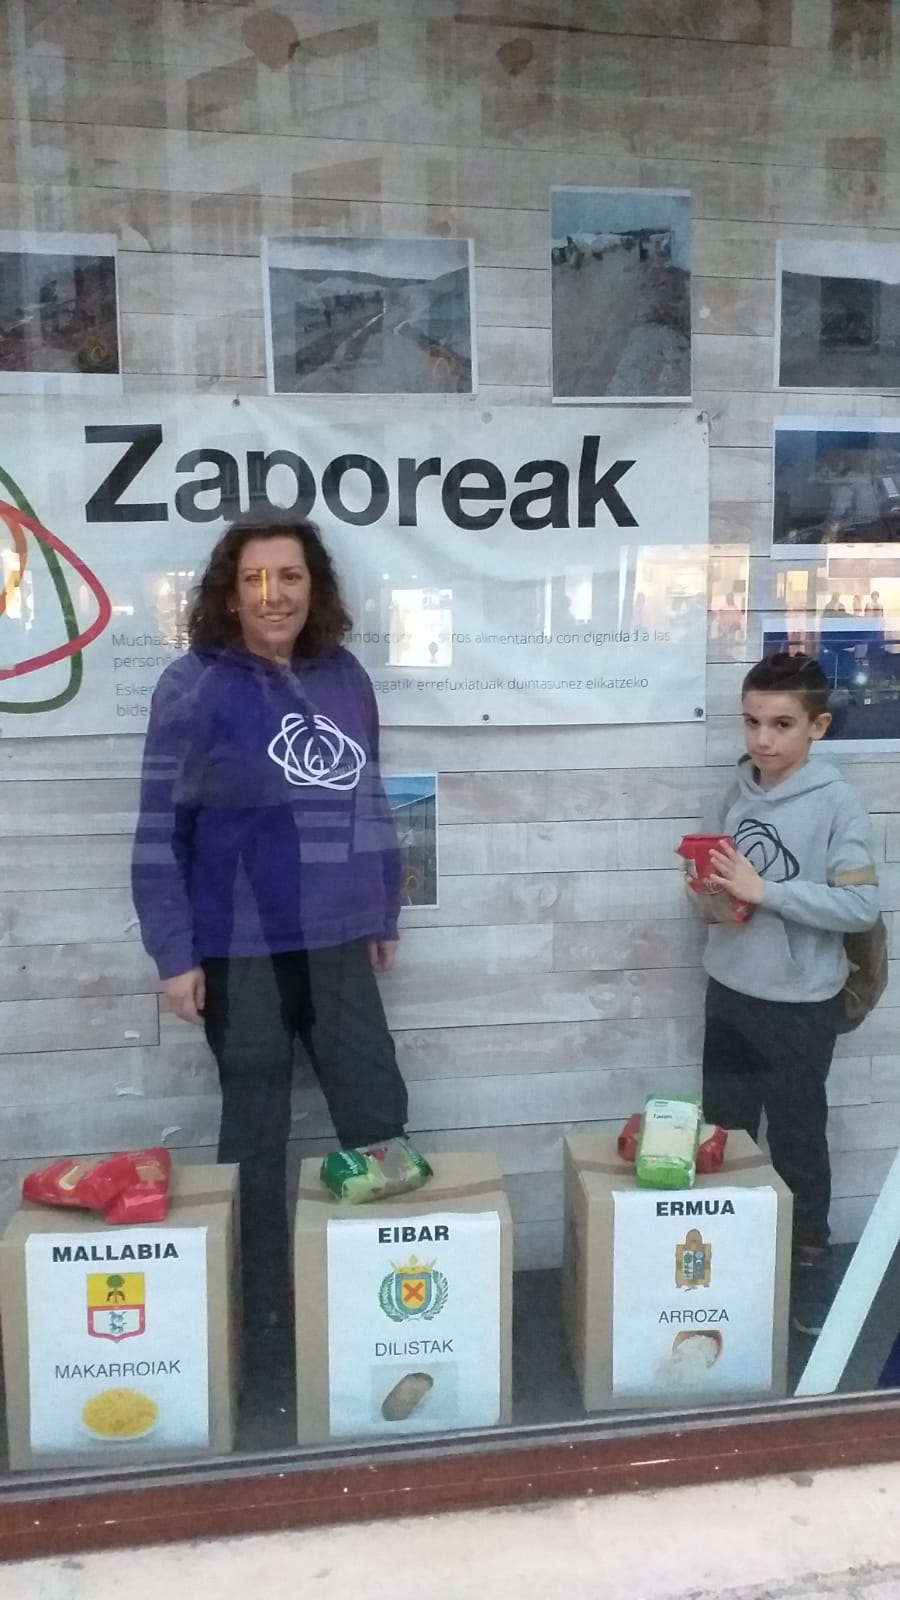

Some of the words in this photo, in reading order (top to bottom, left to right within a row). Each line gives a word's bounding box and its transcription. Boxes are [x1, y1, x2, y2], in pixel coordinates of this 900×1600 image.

[85, 424, 639, 531] Zaporeak
[111, 633, 169, 647] Muchas
[475, 632, 552, 645] alimentando
[556, 632, 580, 644] con
[583, 629, 639, 647] dignidad
[642, 632, 650, 643] a
[654, 629, 672, 643] las
[113, 656, 172, 671] person
[115, 683, 155, 696] Esker
[374, 678, 412, 694] agatik
[416, 678, 503, 692] errefuxiatuak
[507, 677, 583, 691] duintasunez
[586, 675, 649, 690] elikatzeko
[116, 703, 149, 717] bide
[655, 1199, 735, 1218] ERMUA
[377, 1224, 450, 1244] EIBAR
[52, 1242, 179, 1263] MALLABIA
[658, 1308, 730, 1325] ARROZA
[374, 1338, 454, 1357] DILISTAK
[55, 1359, 181, 1380] MAKARROIAK
